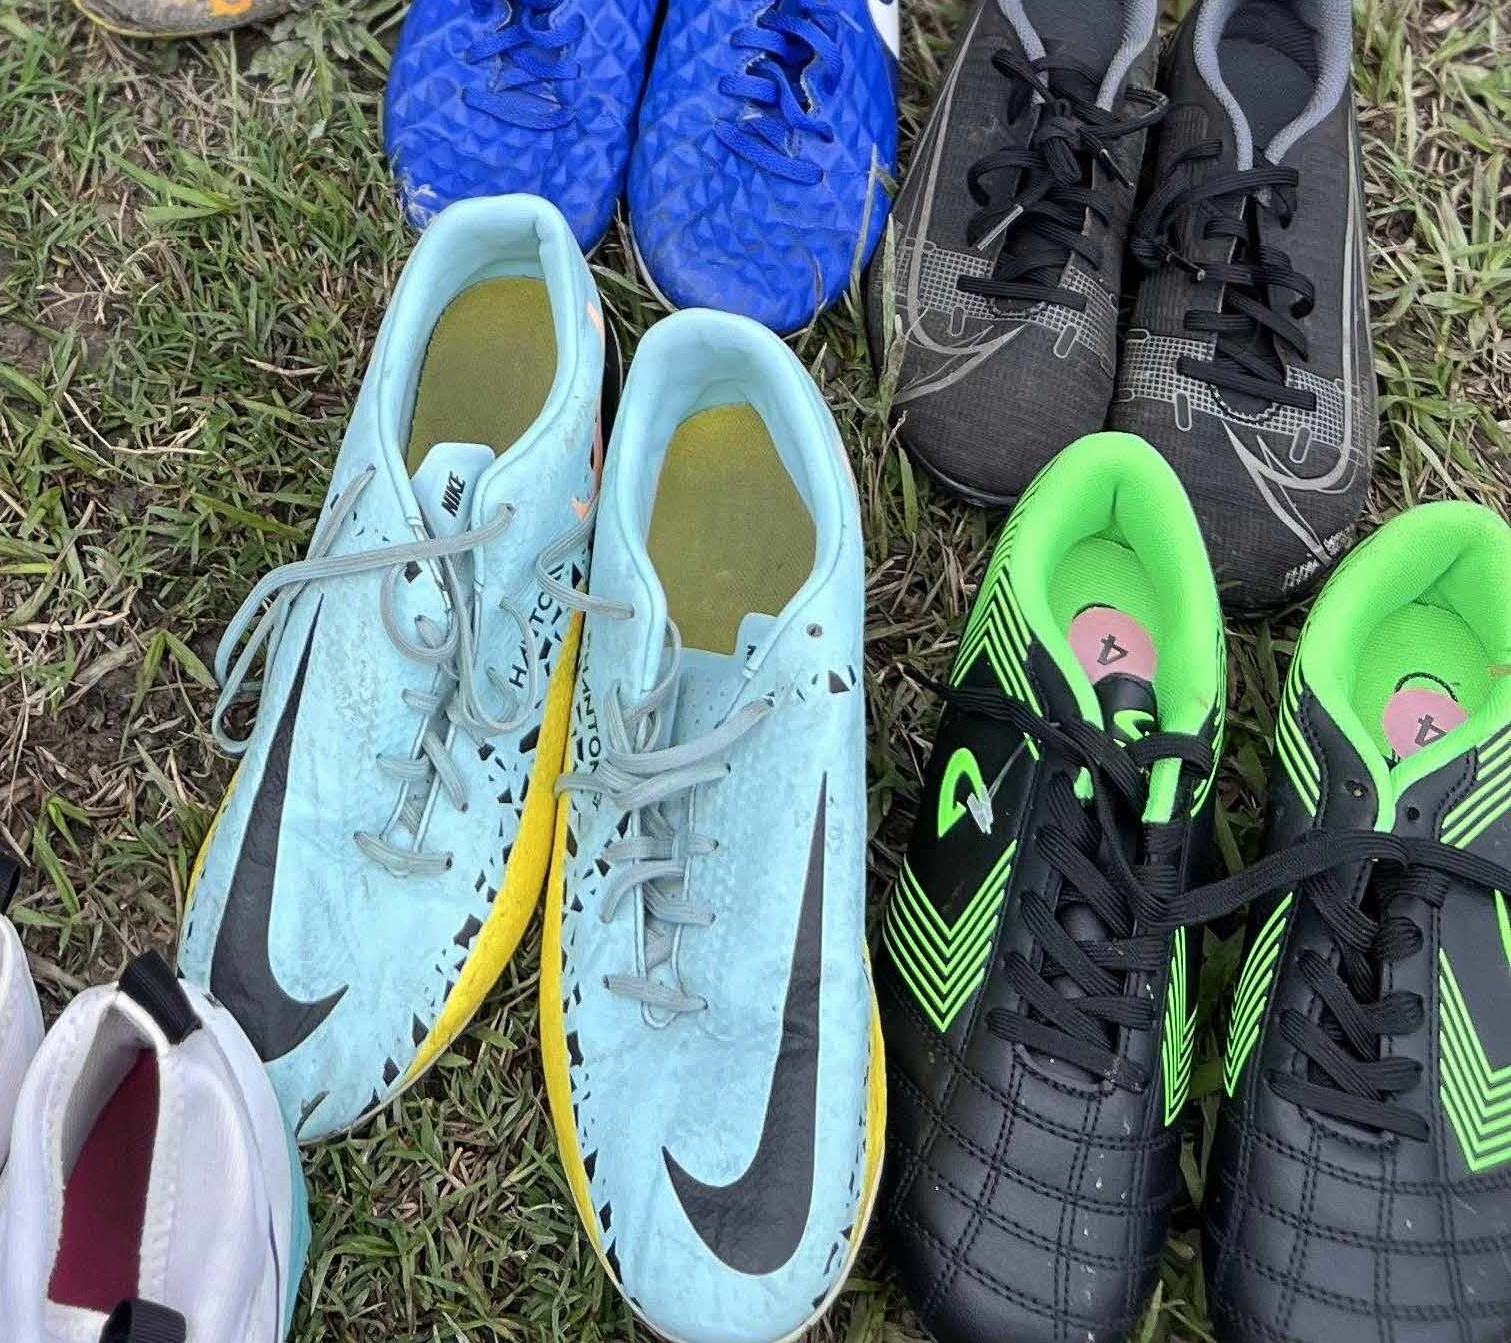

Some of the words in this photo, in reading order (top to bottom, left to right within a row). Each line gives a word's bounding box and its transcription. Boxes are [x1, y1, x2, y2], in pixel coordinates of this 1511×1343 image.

[441, 470, 467, 518] NIKE
[1096, 633, 1129, 666] 4
[1414, 713, 1448, 748] 4
